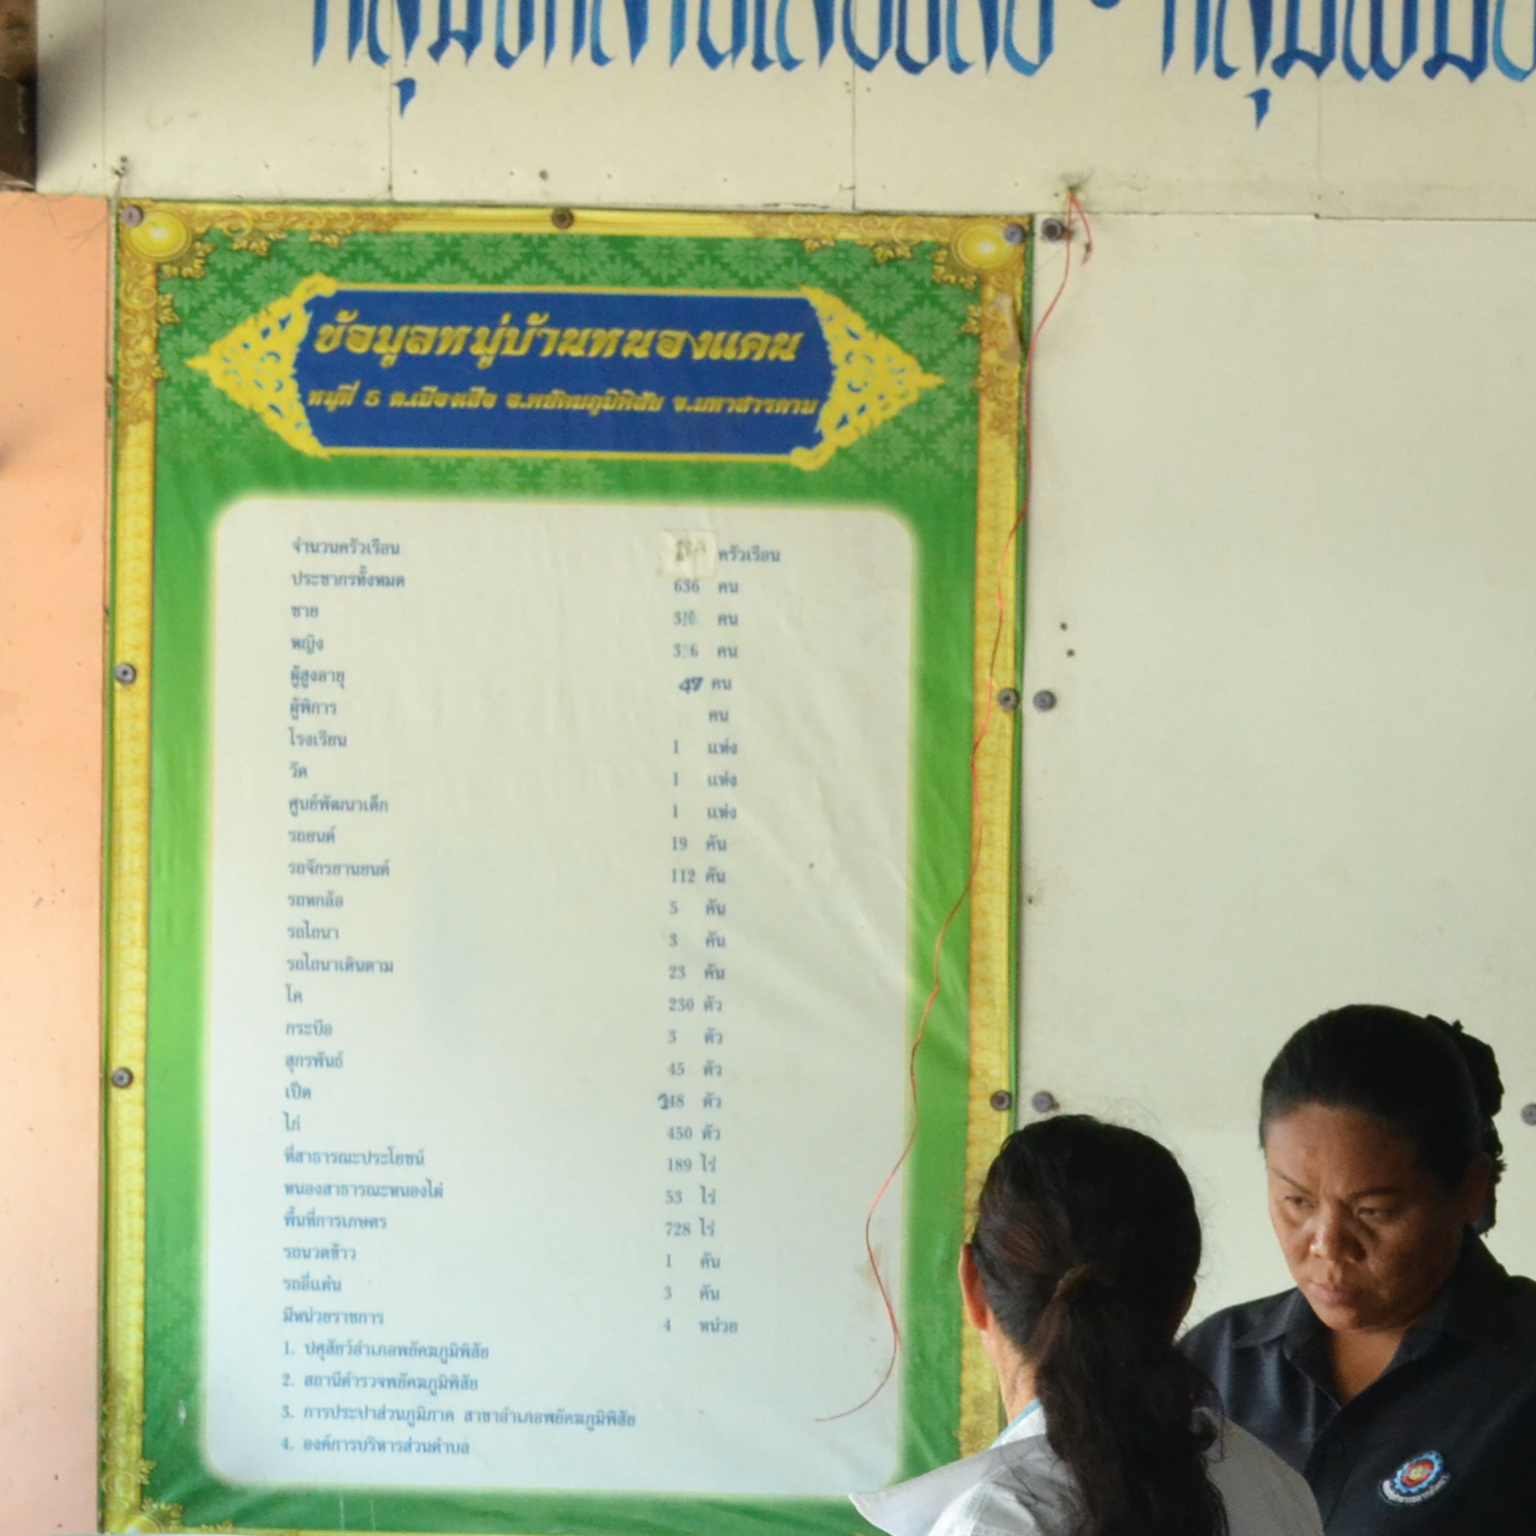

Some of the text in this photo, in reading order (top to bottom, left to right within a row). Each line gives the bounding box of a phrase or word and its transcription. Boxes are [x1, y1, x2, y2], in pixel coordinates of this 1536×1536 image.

[293, 537, 400, 555] จำนวนครัวเรือน
